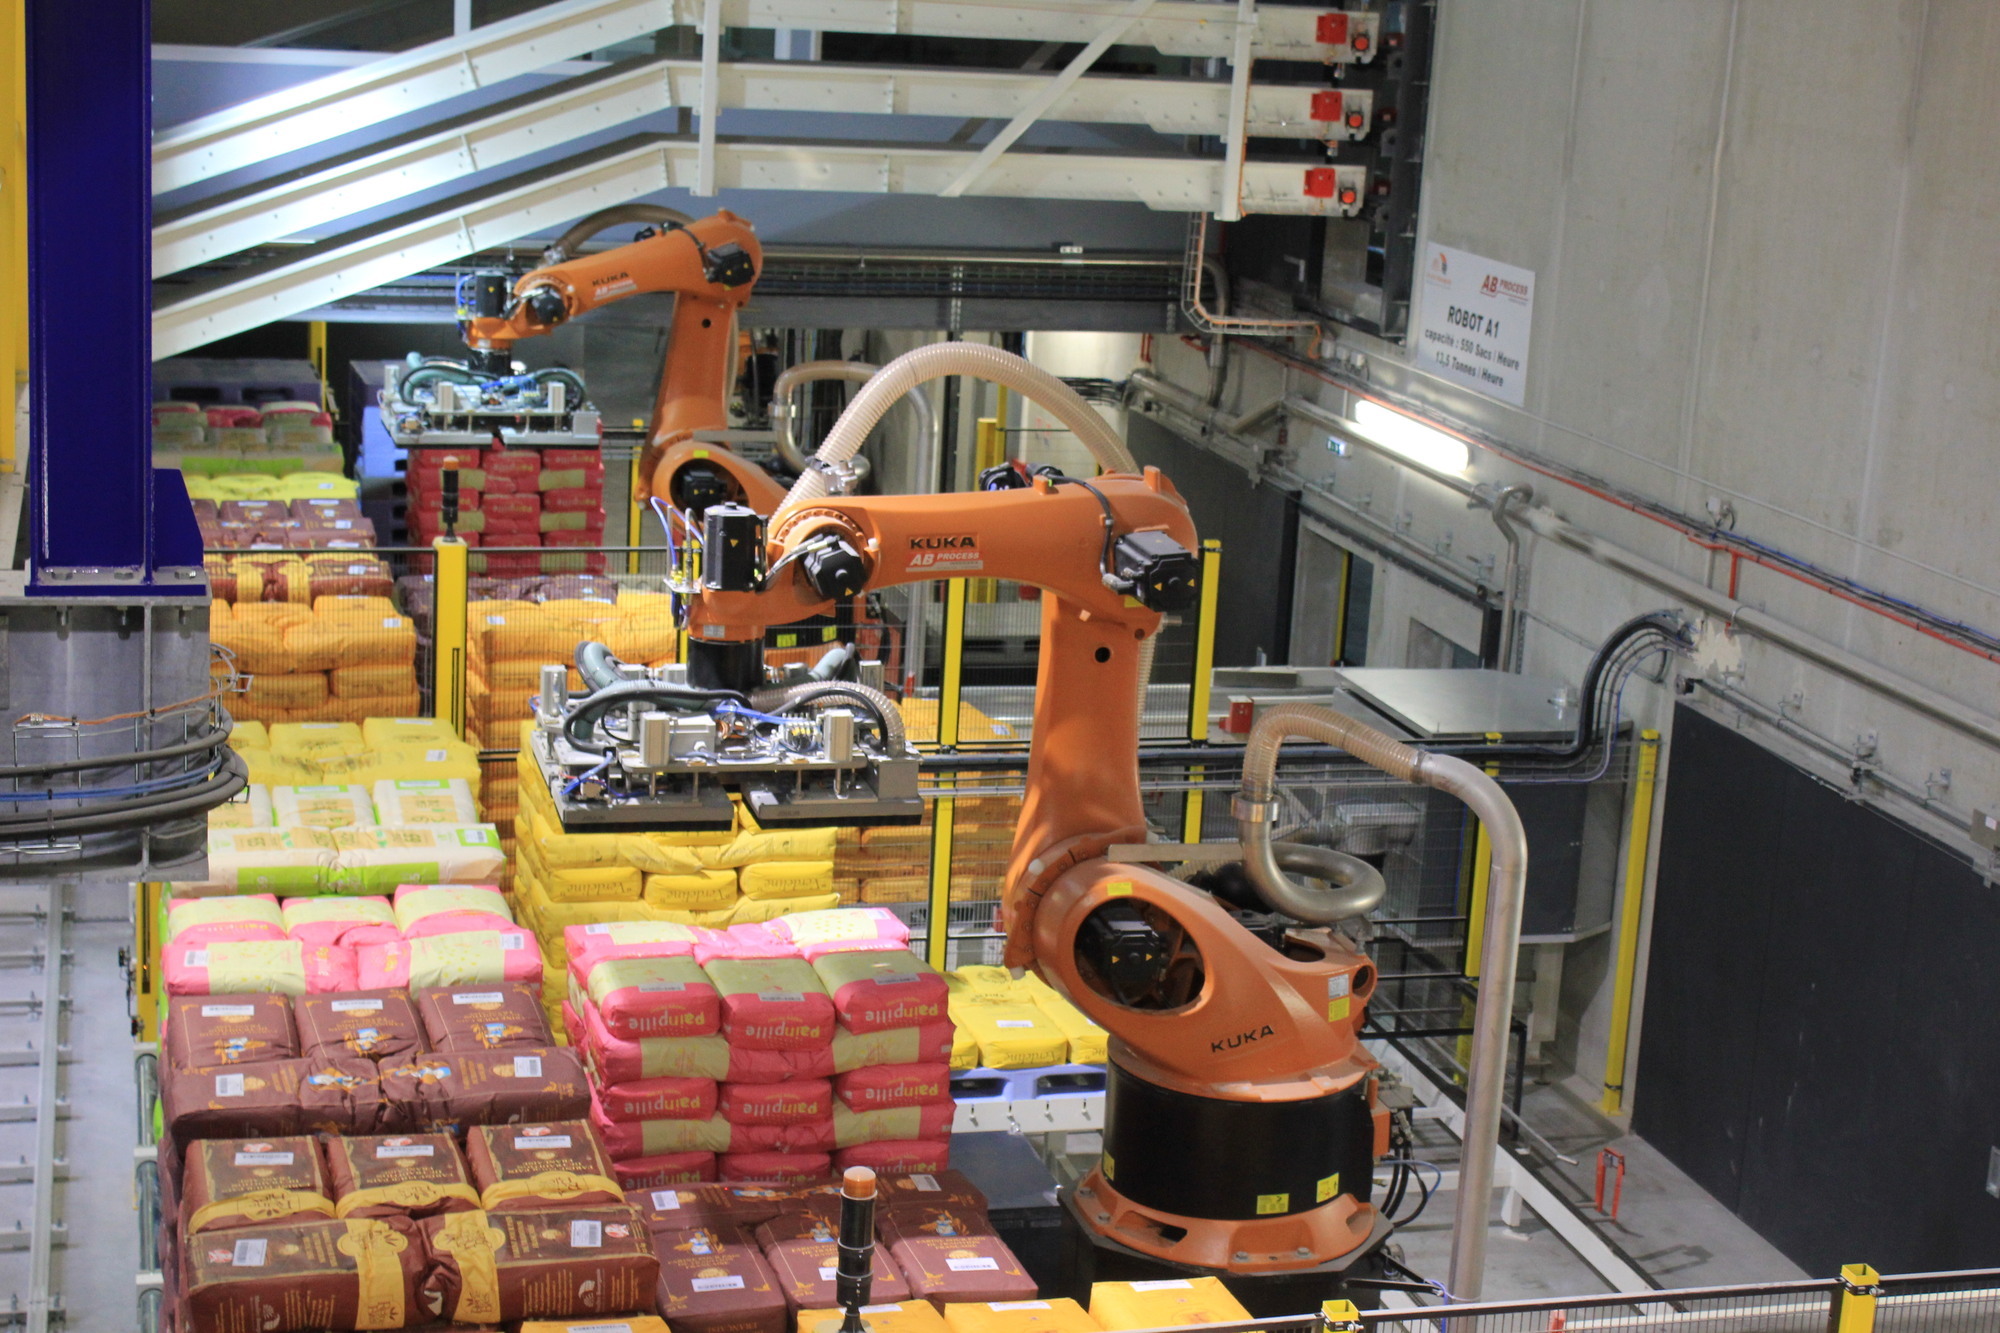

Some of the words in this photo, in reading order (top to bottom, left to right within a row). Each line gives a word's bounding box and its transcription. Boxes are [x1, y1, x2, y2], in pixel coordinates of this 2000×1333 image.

[1481, 274, 1499, 293] AB
[1500, 278, 1528, 296] PROCESS
[1447, 305, 1484, 332] ROBOT
[1484, 318, 1500, 338] A1
[1460, 338, 1474, 354] 550
[1475, 343, 1492, 361] Sacs
[1496, 351, 1520, 371] Heure
[1451, 356, 1476, 377] Tonnes
[1481, 368, 1504, 387] Heure
[910, 536, 976, 550] KUKA
[909, 553, 935, 567] AB
[936, 551, 980, 561] PROCESS
[1210, 1024, 1275, 1053] KUKA
